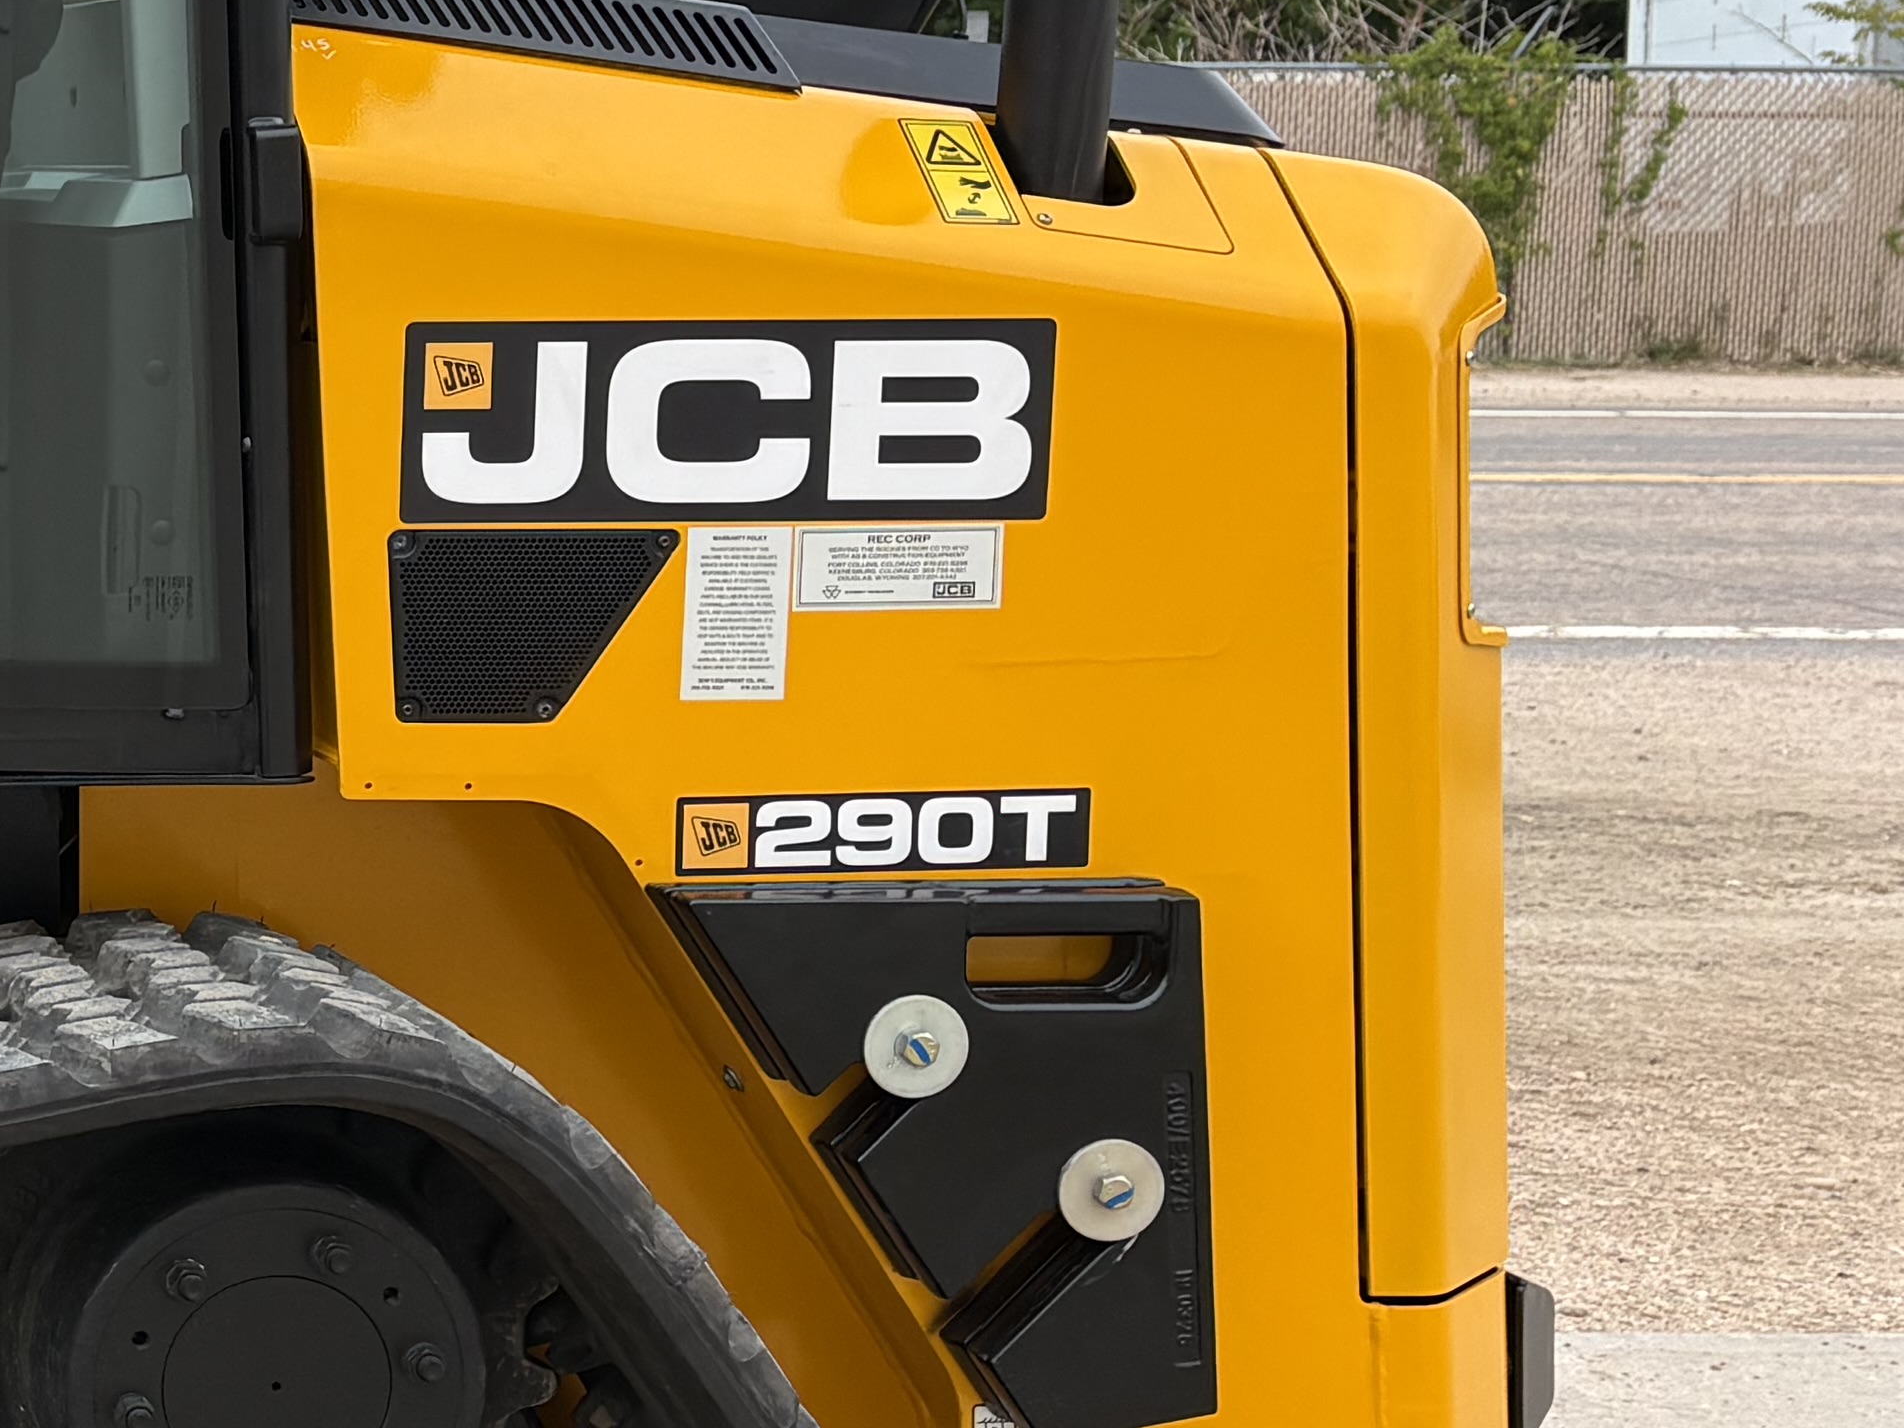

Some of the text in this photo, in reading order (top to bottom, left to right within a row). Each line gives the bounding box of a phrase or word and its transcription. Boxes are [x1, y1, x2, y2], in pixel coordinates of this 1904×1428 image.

[442, 360, 481, 392] JCB
[420, 337, 1035, 504] JCB
[867, 534, 932, 544] REC CORP
[936, 585, 972, 596] JCB
[700, 821, 738, 851] JCB
[754, 795, 1077, 868] 290T
